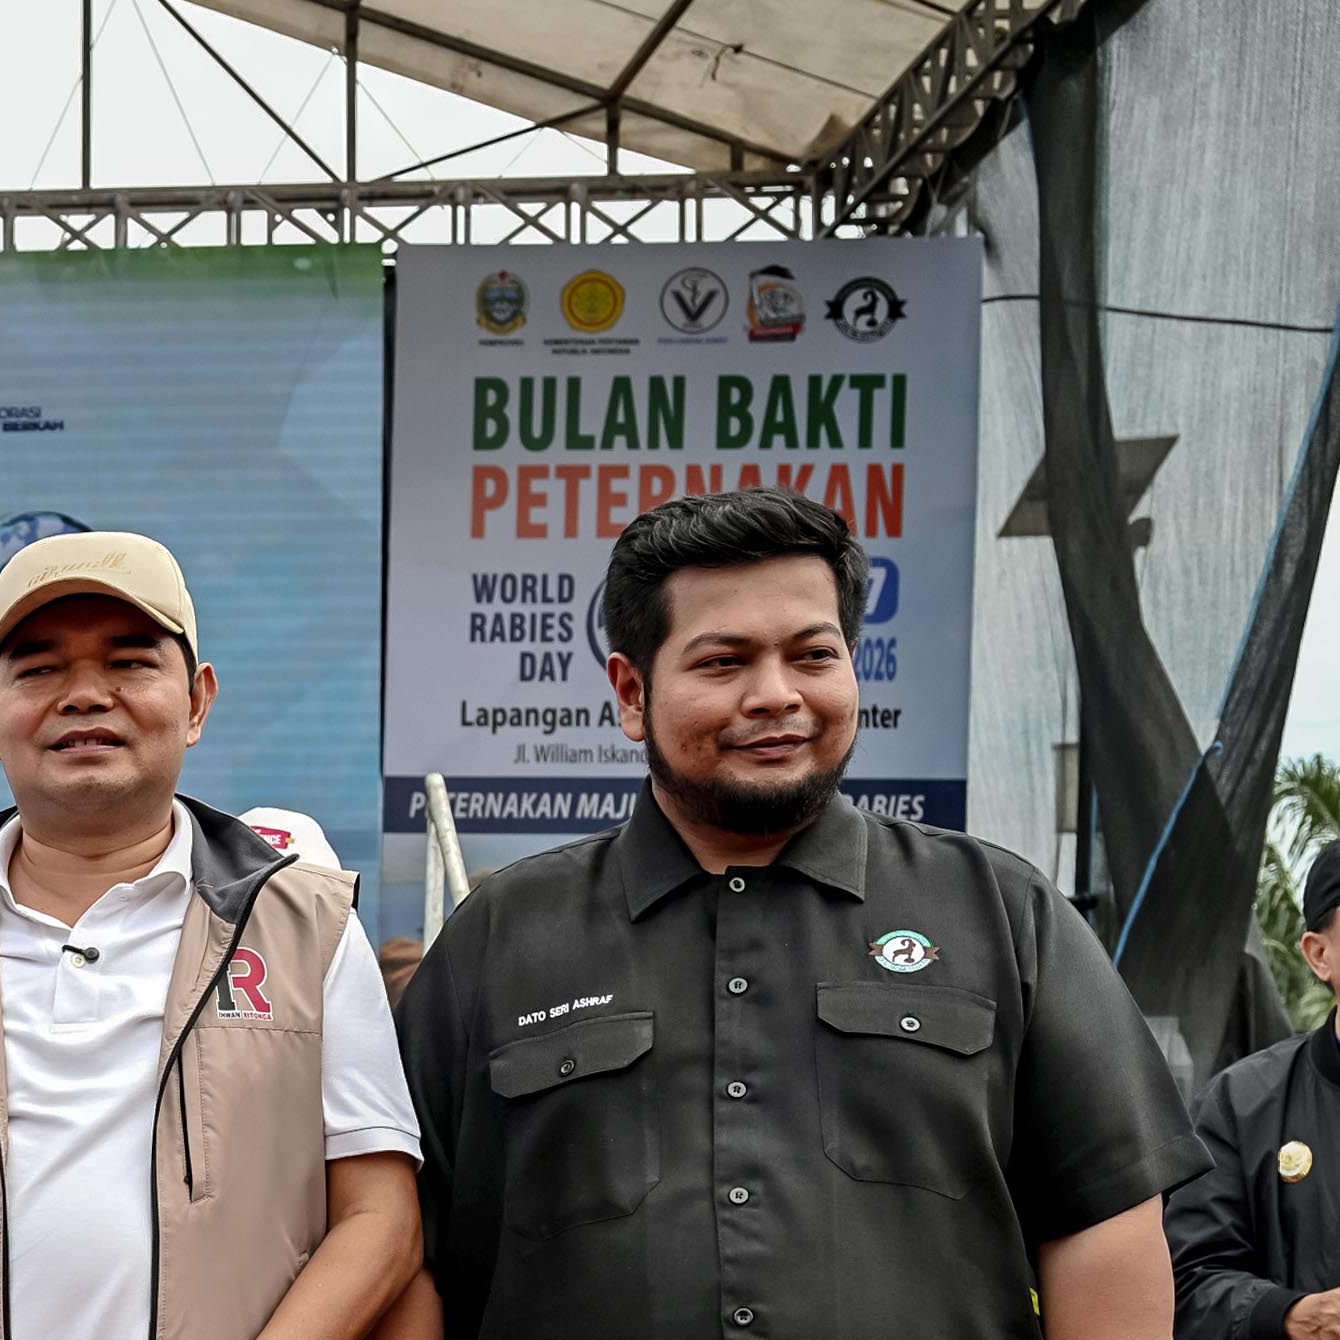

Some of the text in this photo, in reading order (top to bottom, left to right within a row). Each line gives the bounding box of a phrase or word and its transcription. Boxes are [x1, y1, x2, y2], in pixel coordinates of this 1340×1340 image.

[472, 373, 908, 452] BULAN BAKTI
[471, 572, 575, 605] WORLD
[469, 612, 573, 644] RABIES
[519, 651, 573, 682] DAY
[461, 700, 590, 735] Lapangan
[860, 704, 902, 729] nter
[534, 744, 594, 764] William
[410, 791, 572, 820] PTERNAKAN
[518, 993, 614, 1028] DATO SERI ASHRAF
